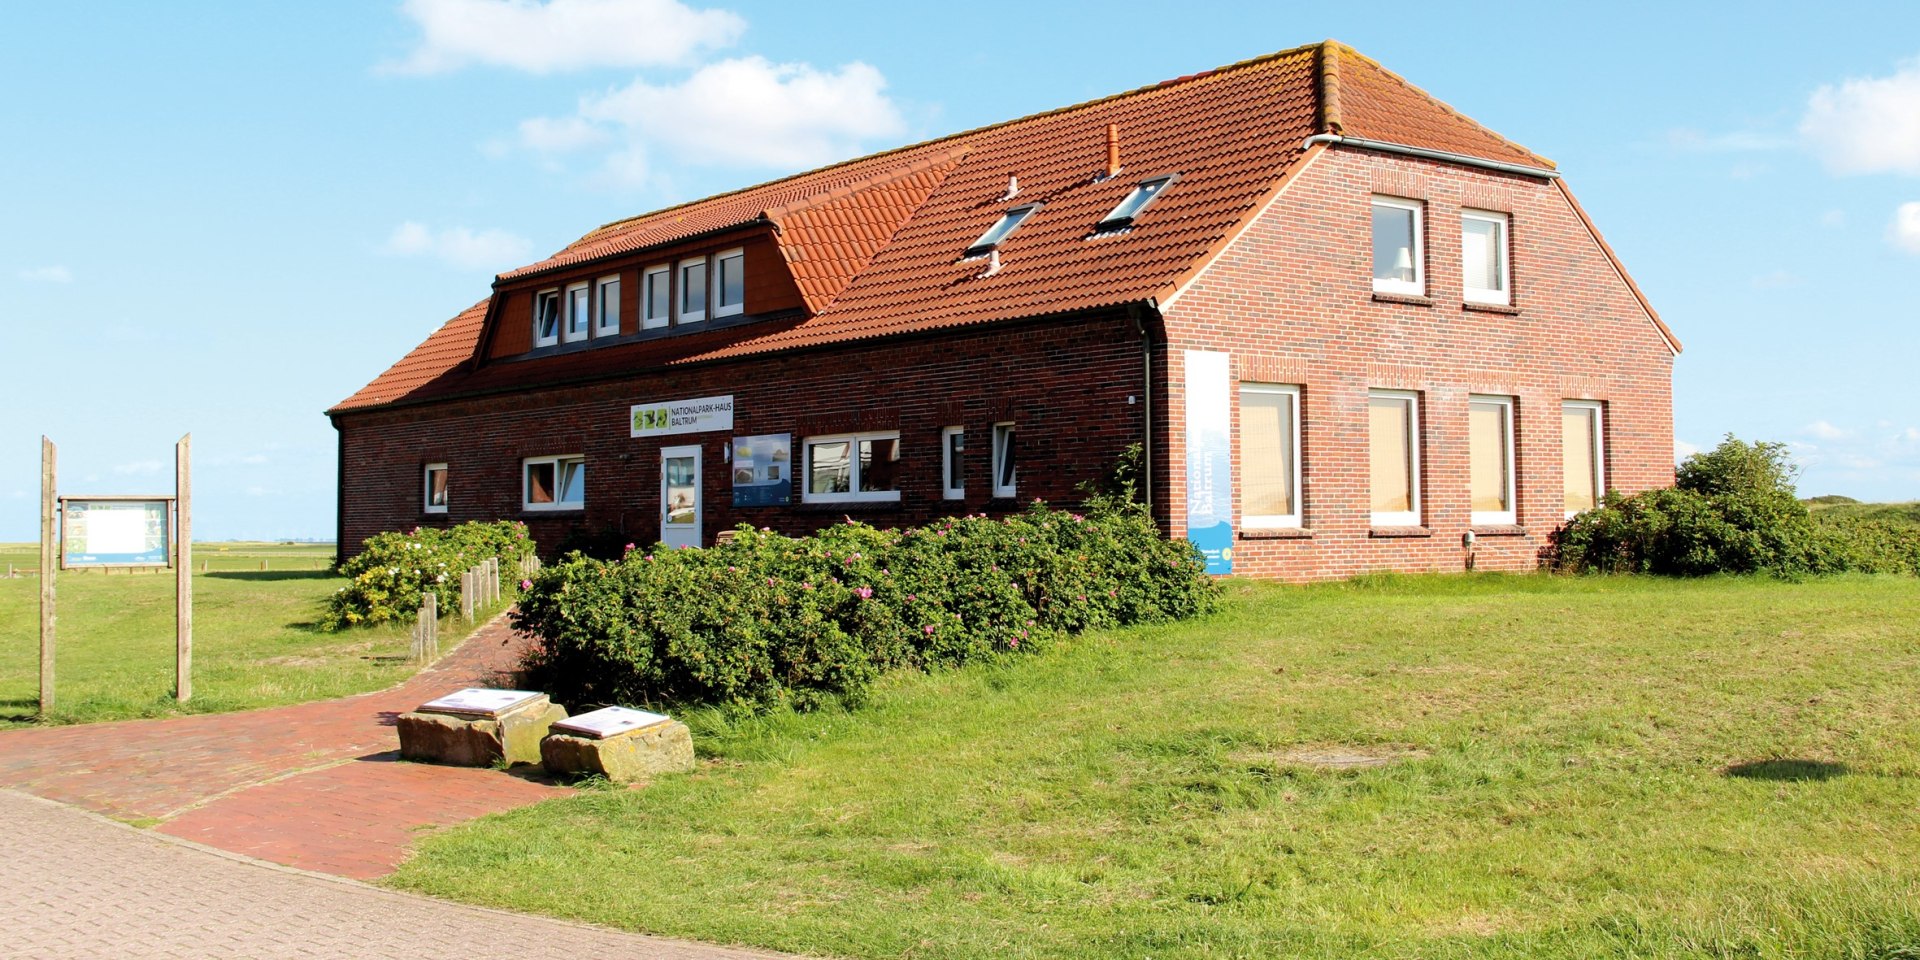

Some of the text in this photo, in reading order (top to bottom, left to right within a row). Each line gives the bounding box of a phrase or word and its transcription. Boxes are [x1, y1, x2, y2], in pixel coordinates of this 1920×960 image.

[671, 402, 731, 416] NATIONALPARK-HAUS
[671, 416, 697, 426] BALTRUM
[1201, 452, 1212, 514] Baltrum
